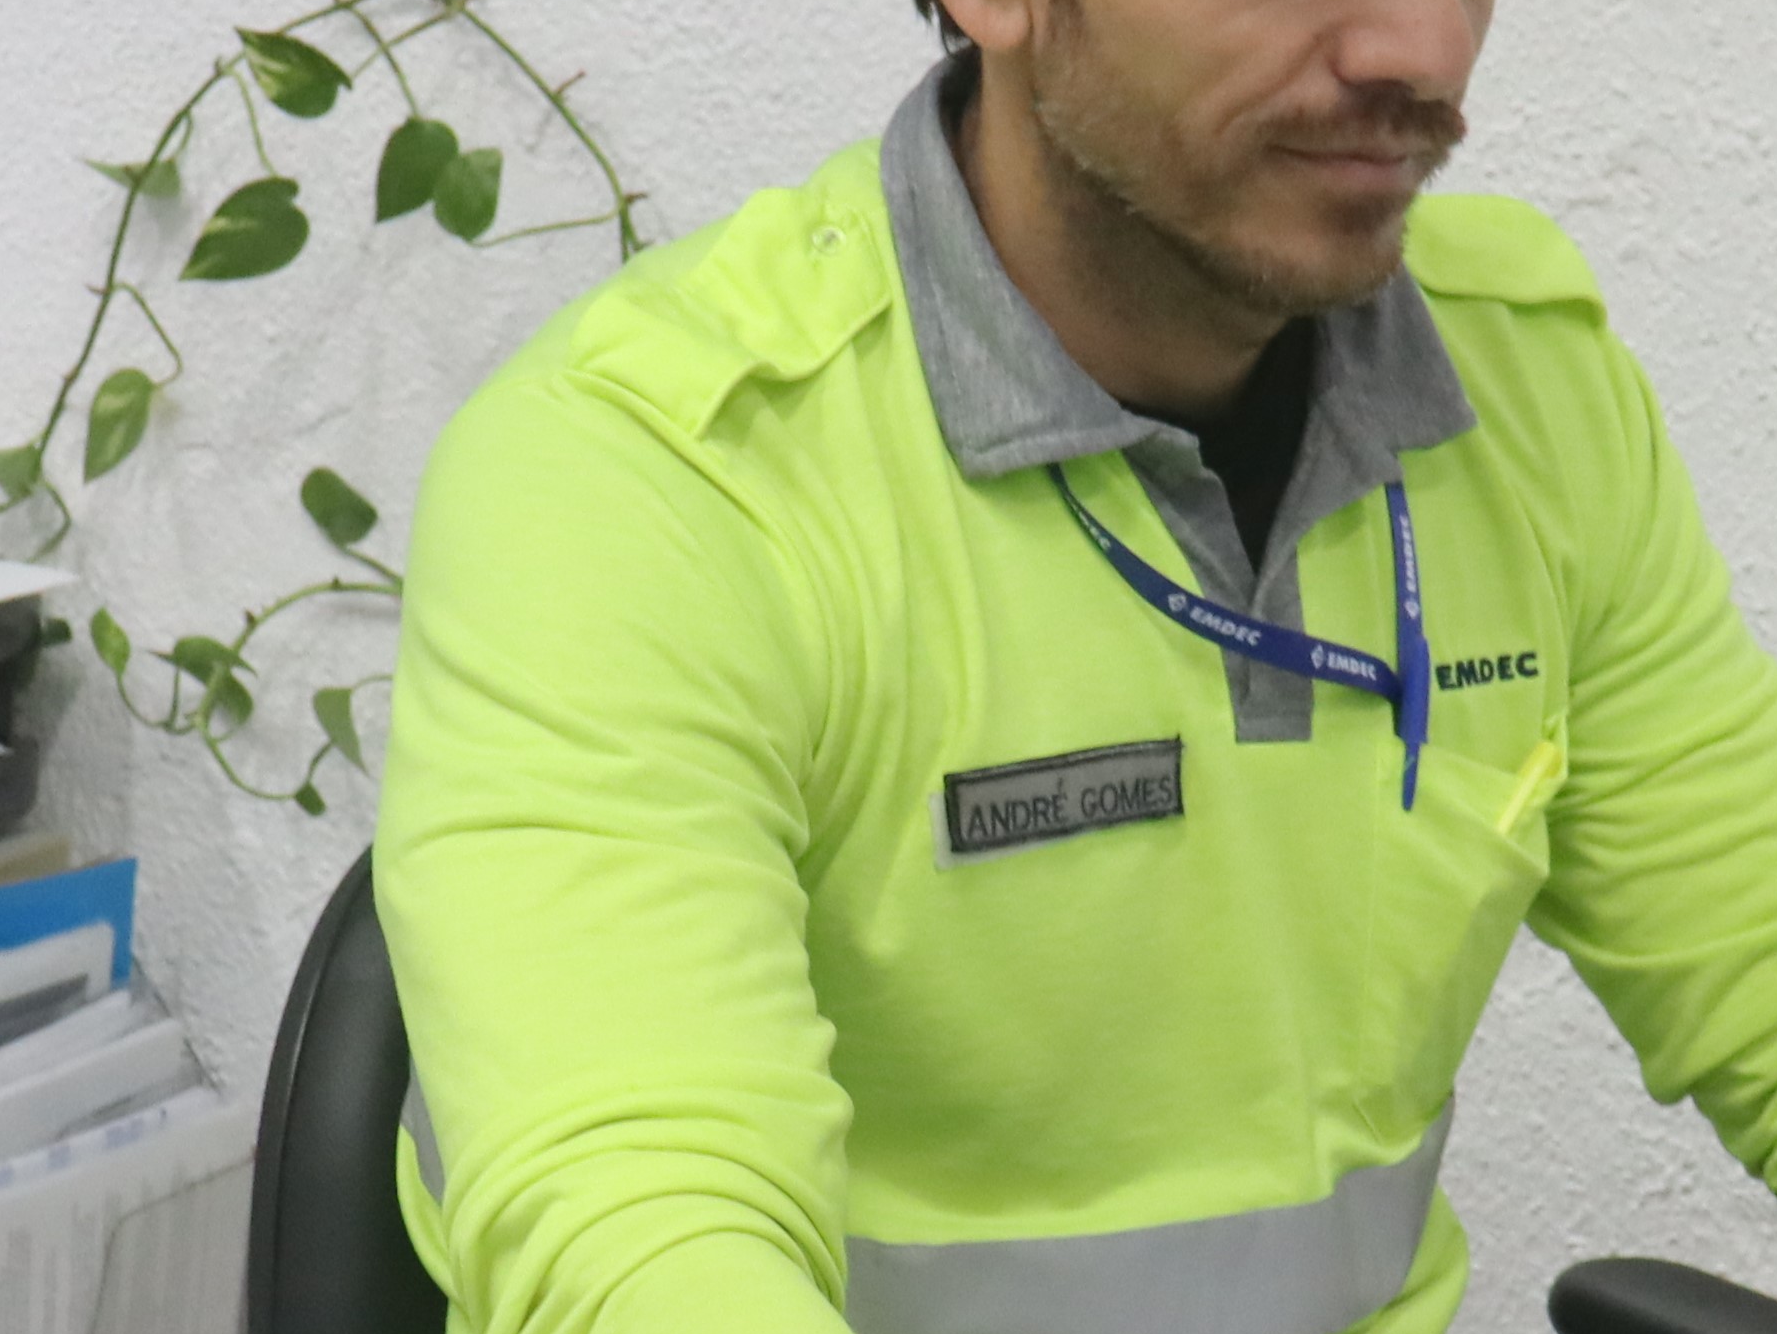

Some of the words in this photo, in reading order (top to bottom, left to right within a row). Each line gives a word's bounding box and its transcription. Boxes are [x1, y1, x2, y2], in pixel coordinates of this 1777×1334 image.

[1401, 514, 1420, 594] EMDEC
[1189, 605, 1262, 647] EMDEC
[1327, 649, 1377, 682] EMDEC
[1436, 651, 1540, 691] EMDEC
[967, 779, 1070, 838] ANDRÉ
[1080, 774, 1175, 819] GOMES
